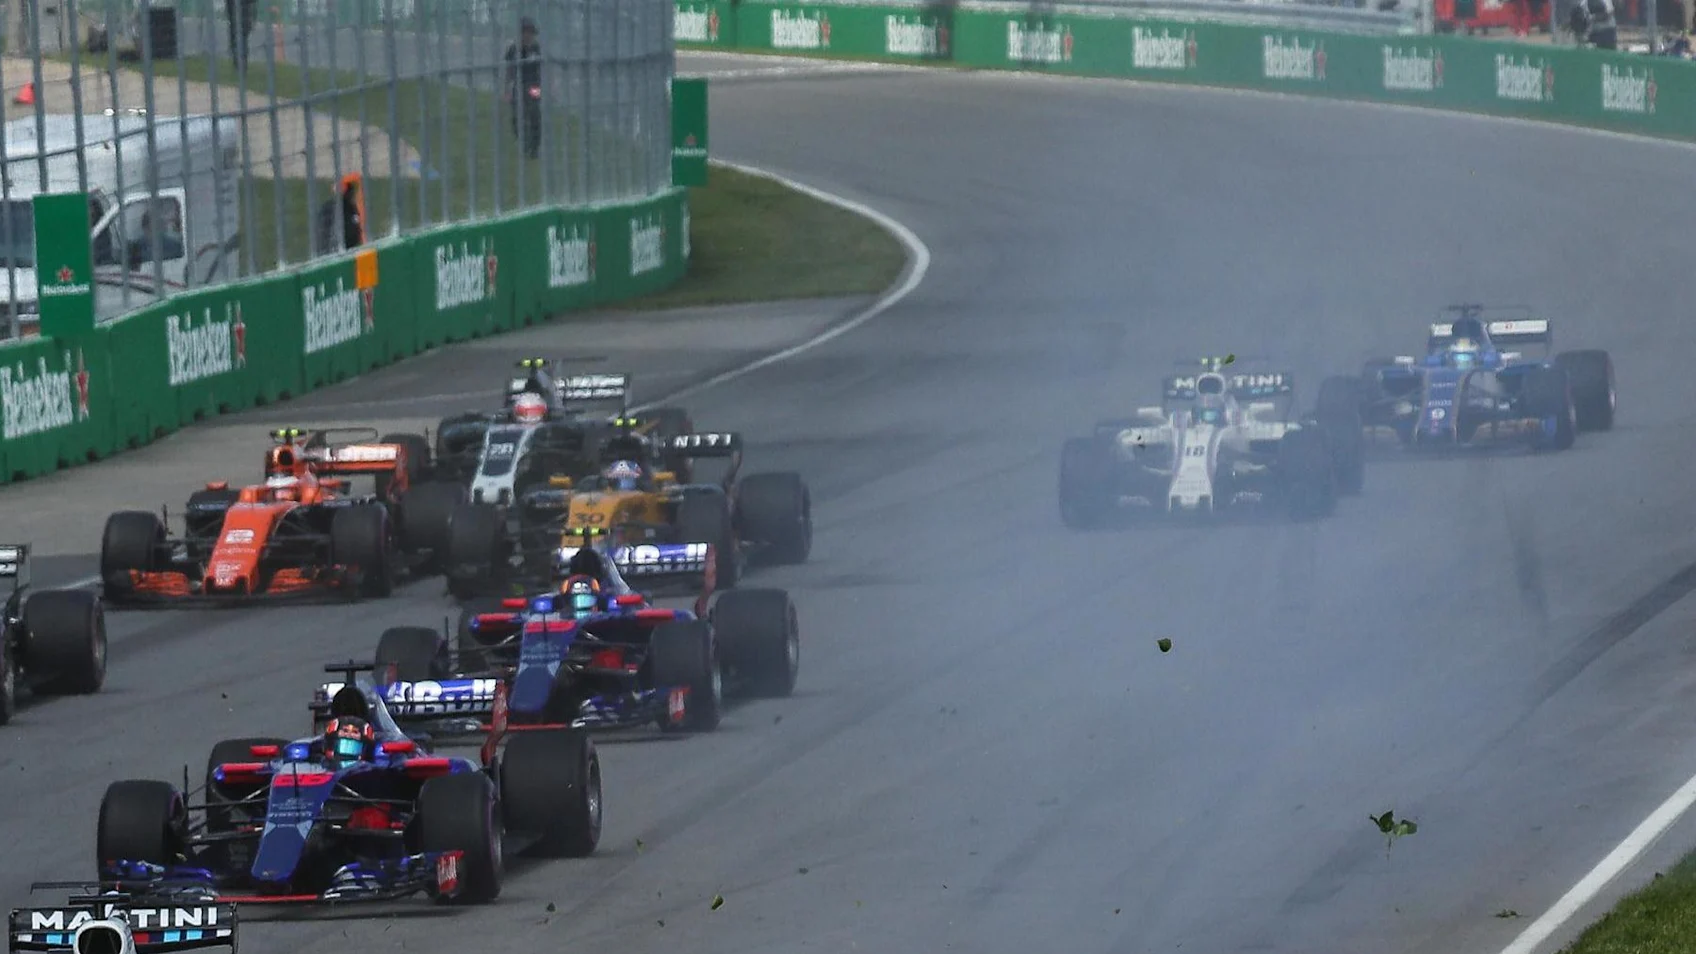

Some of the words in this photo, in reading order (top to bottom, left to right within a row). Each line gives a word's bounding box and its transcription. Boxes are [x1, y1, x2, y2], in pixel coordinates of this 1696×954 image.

[166, 307, 233, 386] Heineken
[304, 277, 362, 353] Heineken
[0, 356, 73, 439] Heineken
[1175, 375, 1283, 388] MTINI
[674, 433, 733, 447] NITI
